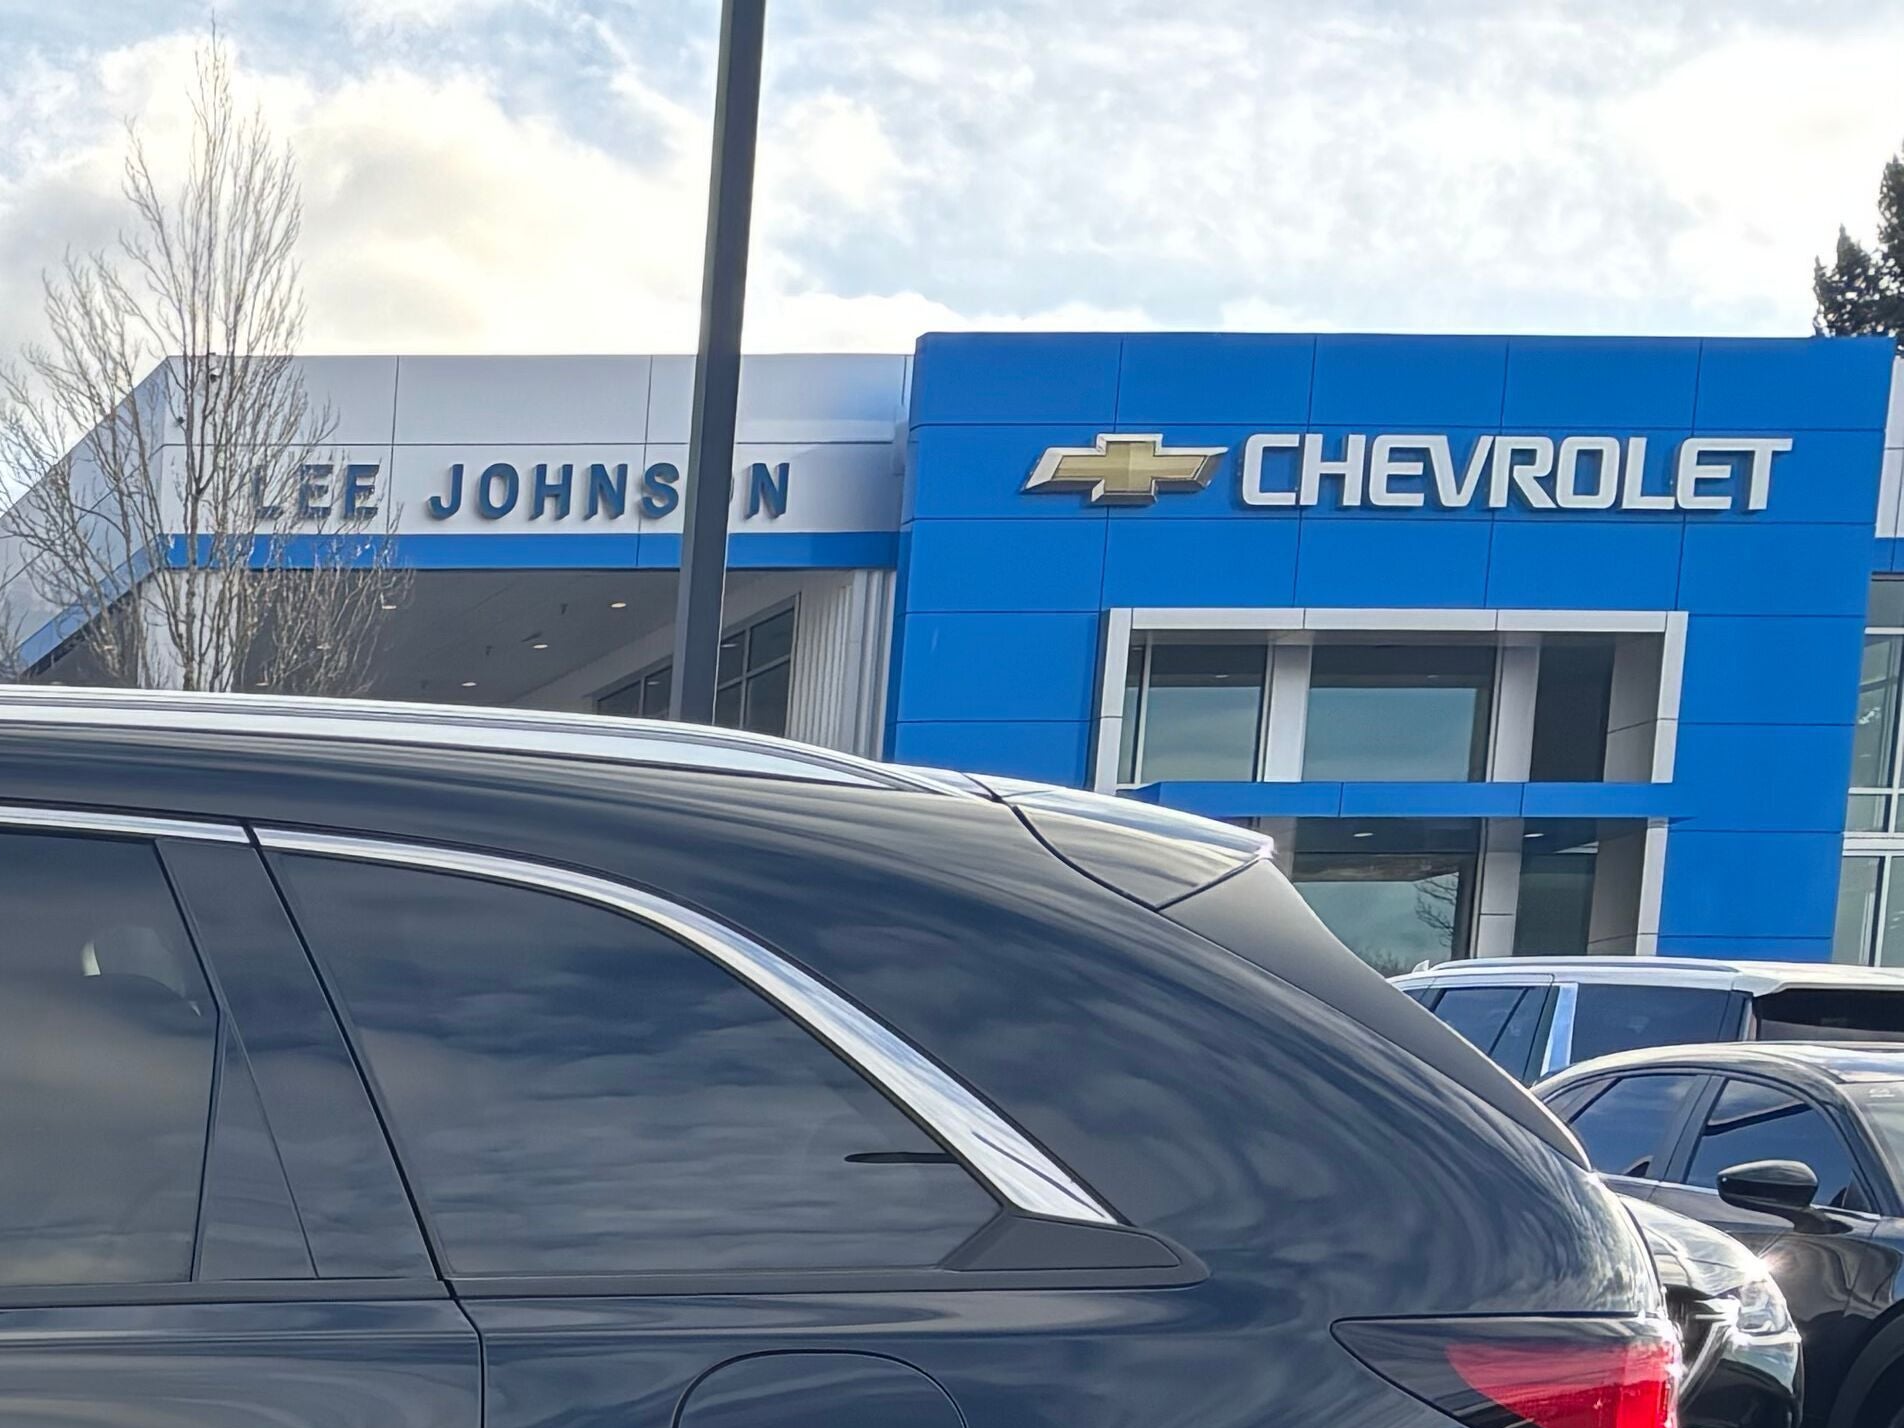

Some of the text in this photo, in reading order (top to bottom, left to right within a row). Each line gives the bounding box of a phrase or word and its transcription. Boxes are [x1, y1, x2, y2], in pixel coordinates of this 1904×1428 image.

[252, 462, 791, 521] LEE JOHNSN
[1242, 433, 1794, 511] CHEVROLET
